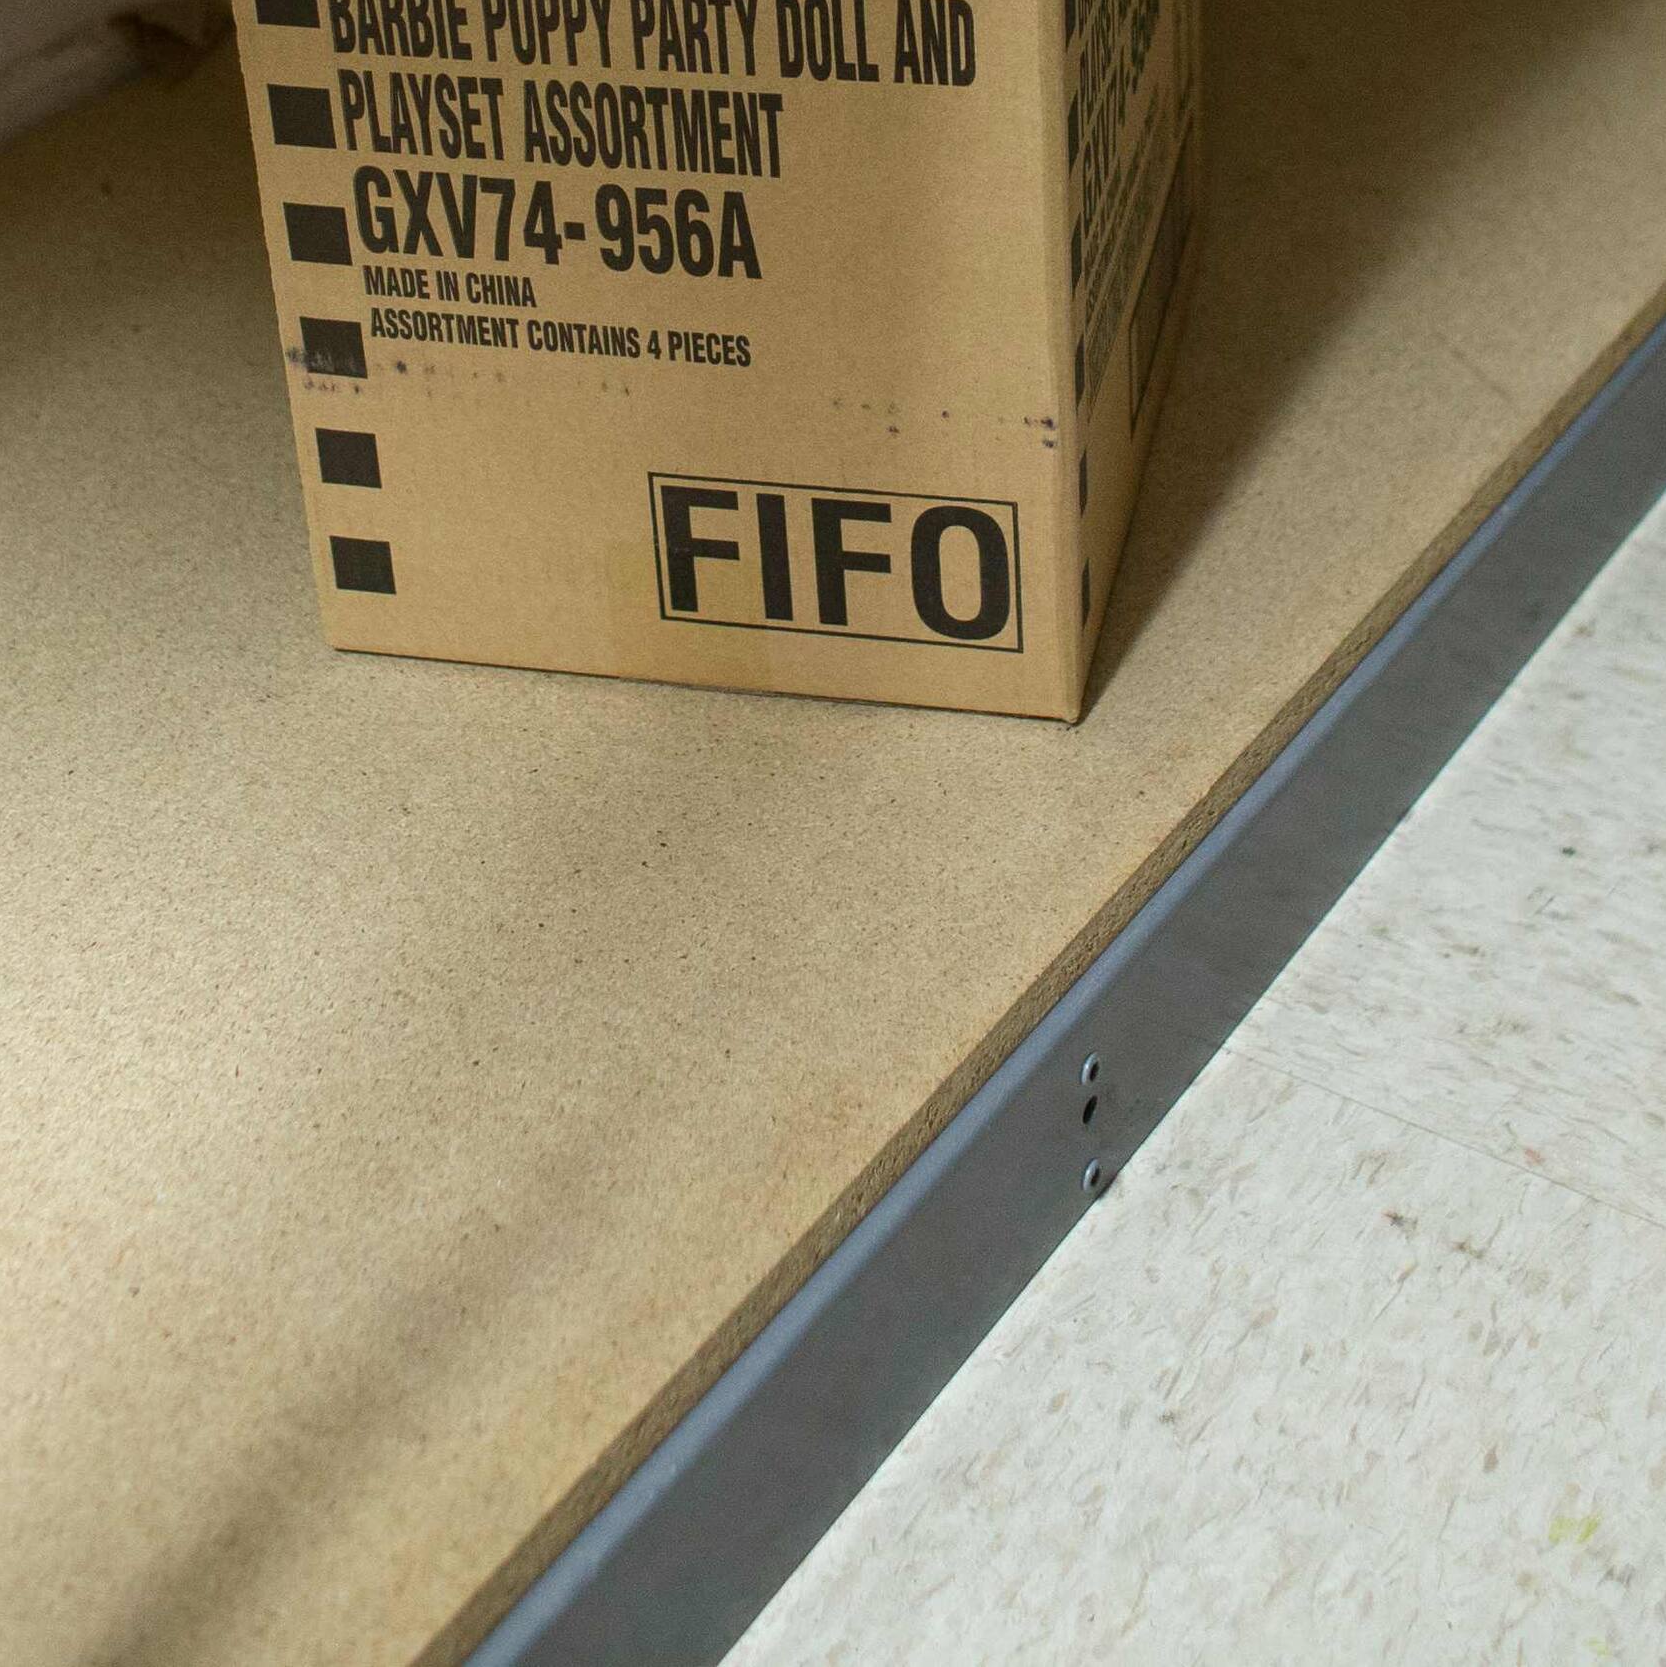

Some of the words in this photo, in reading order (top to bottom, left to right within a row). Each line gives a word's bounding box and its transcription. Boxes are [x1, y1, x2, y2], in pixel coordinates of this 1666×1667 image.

[338, 68, 504, 159] PLAYSET
[524, 80, 783, 178] ASSORTMENT
[353, 166, 762, 279] GXV74-956A
[363, 266, 430, 300] MADE
[436, 270, 460, 302] IN
[466, 271, 536, 308] CHINA
[370, 309, 520, 350] ASSORTMENT
[527, 320, 640, 358] CONTAINS
[647, 329, 661, 360] 4
[668, 332, 751, 366] PIECES
[660, 486, 1010, 640] FIFO
